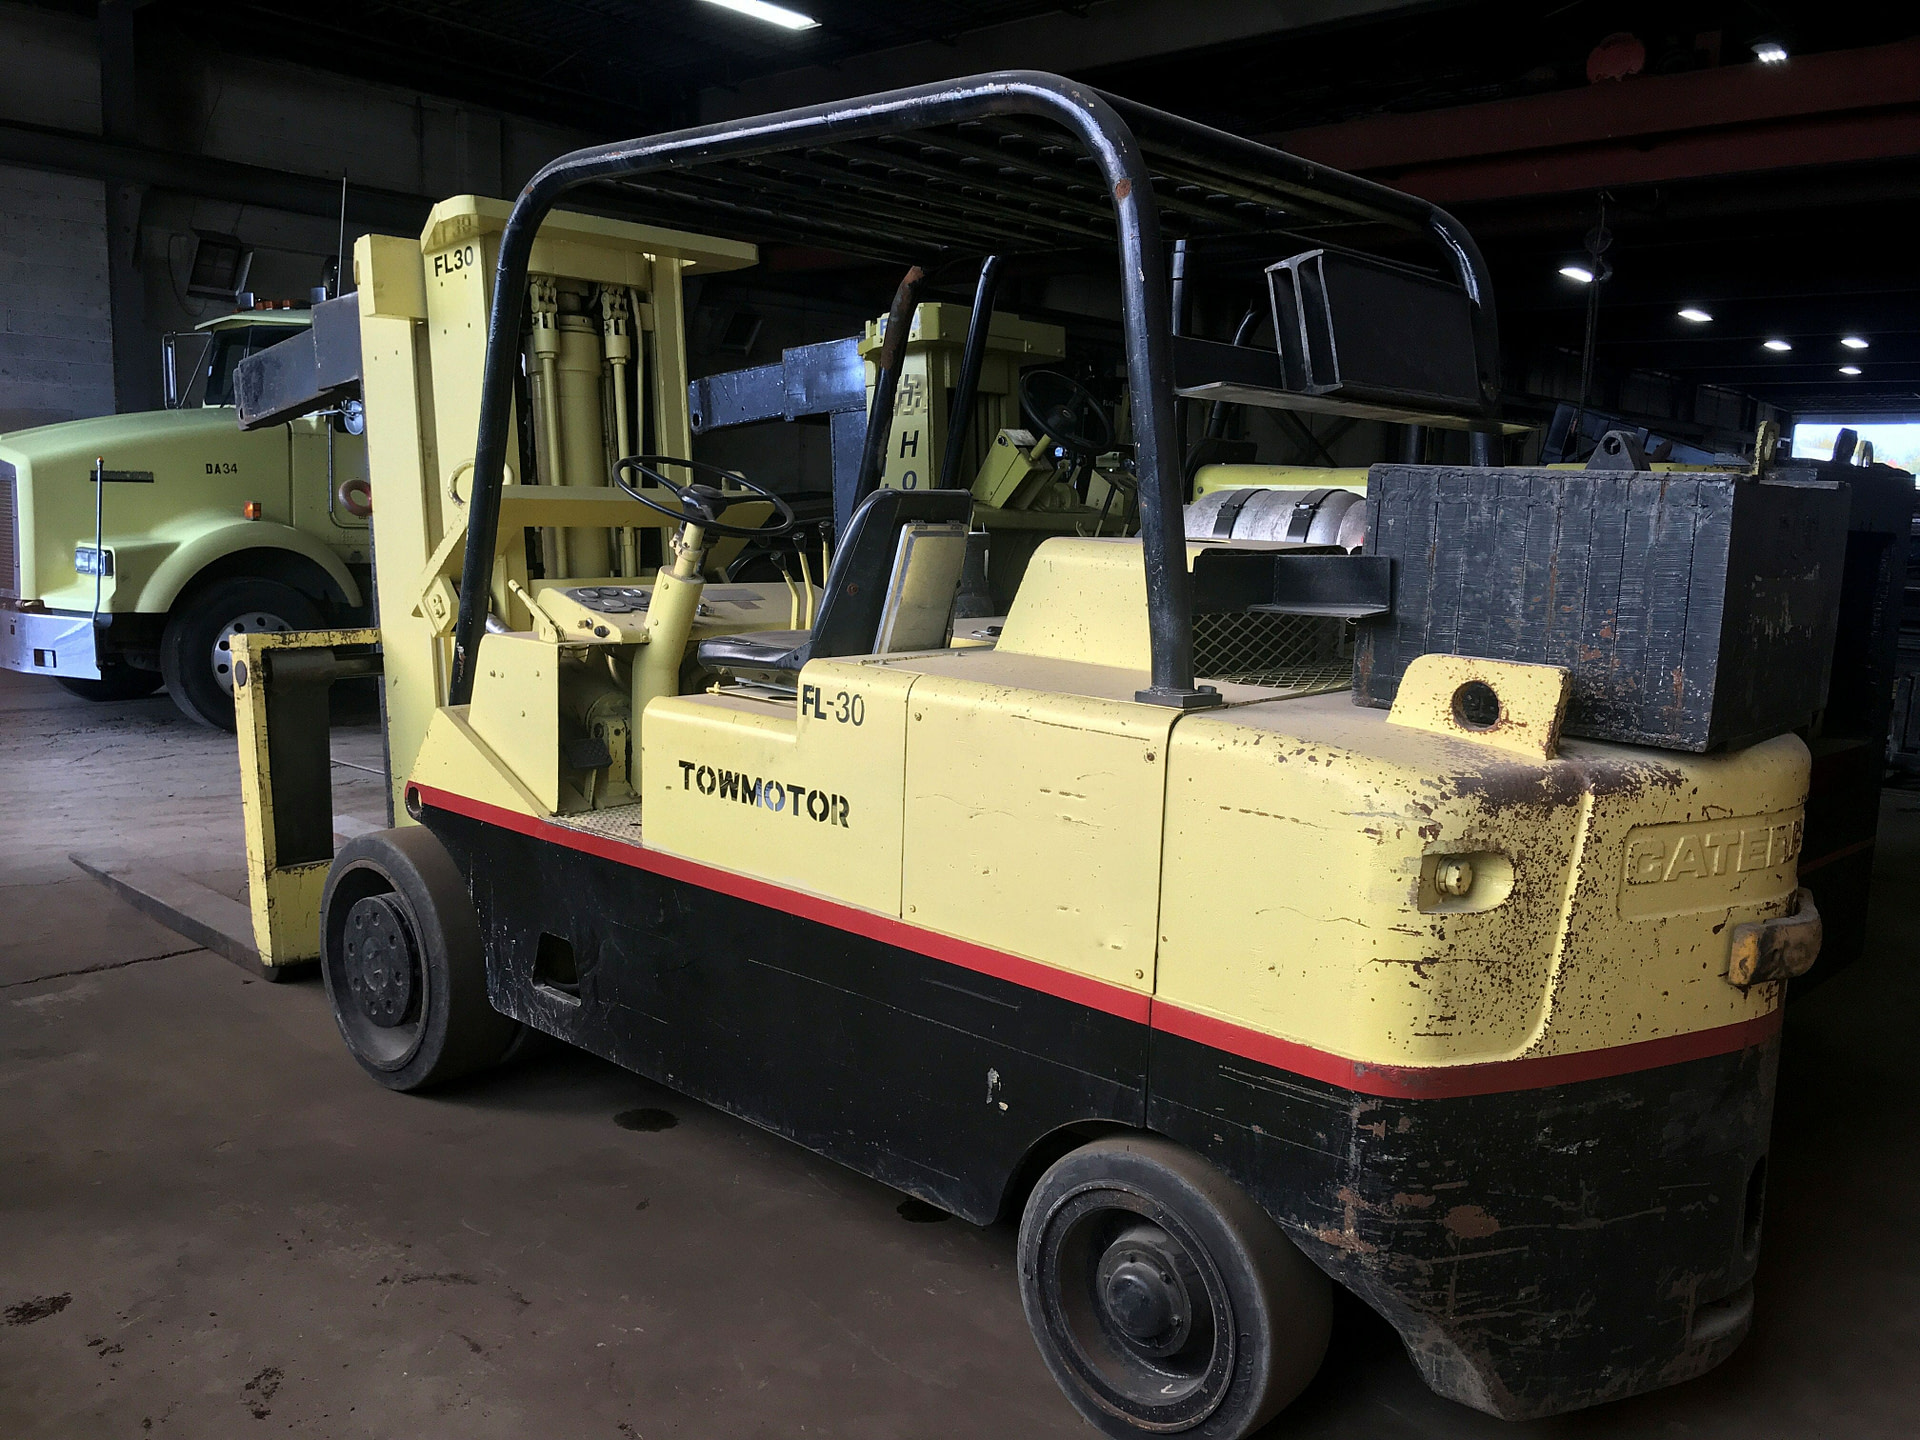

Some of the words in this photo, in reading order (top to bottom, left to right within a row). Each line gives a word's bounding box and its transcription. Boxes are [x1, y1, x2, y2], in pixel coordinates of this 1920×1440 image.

[434, 246, 474, 277] FL30
[205, 463, 238, 474] DA34
[802, 684, 865, 726] FL-30
[678, 759, 850, 828] TOWMOTOR
